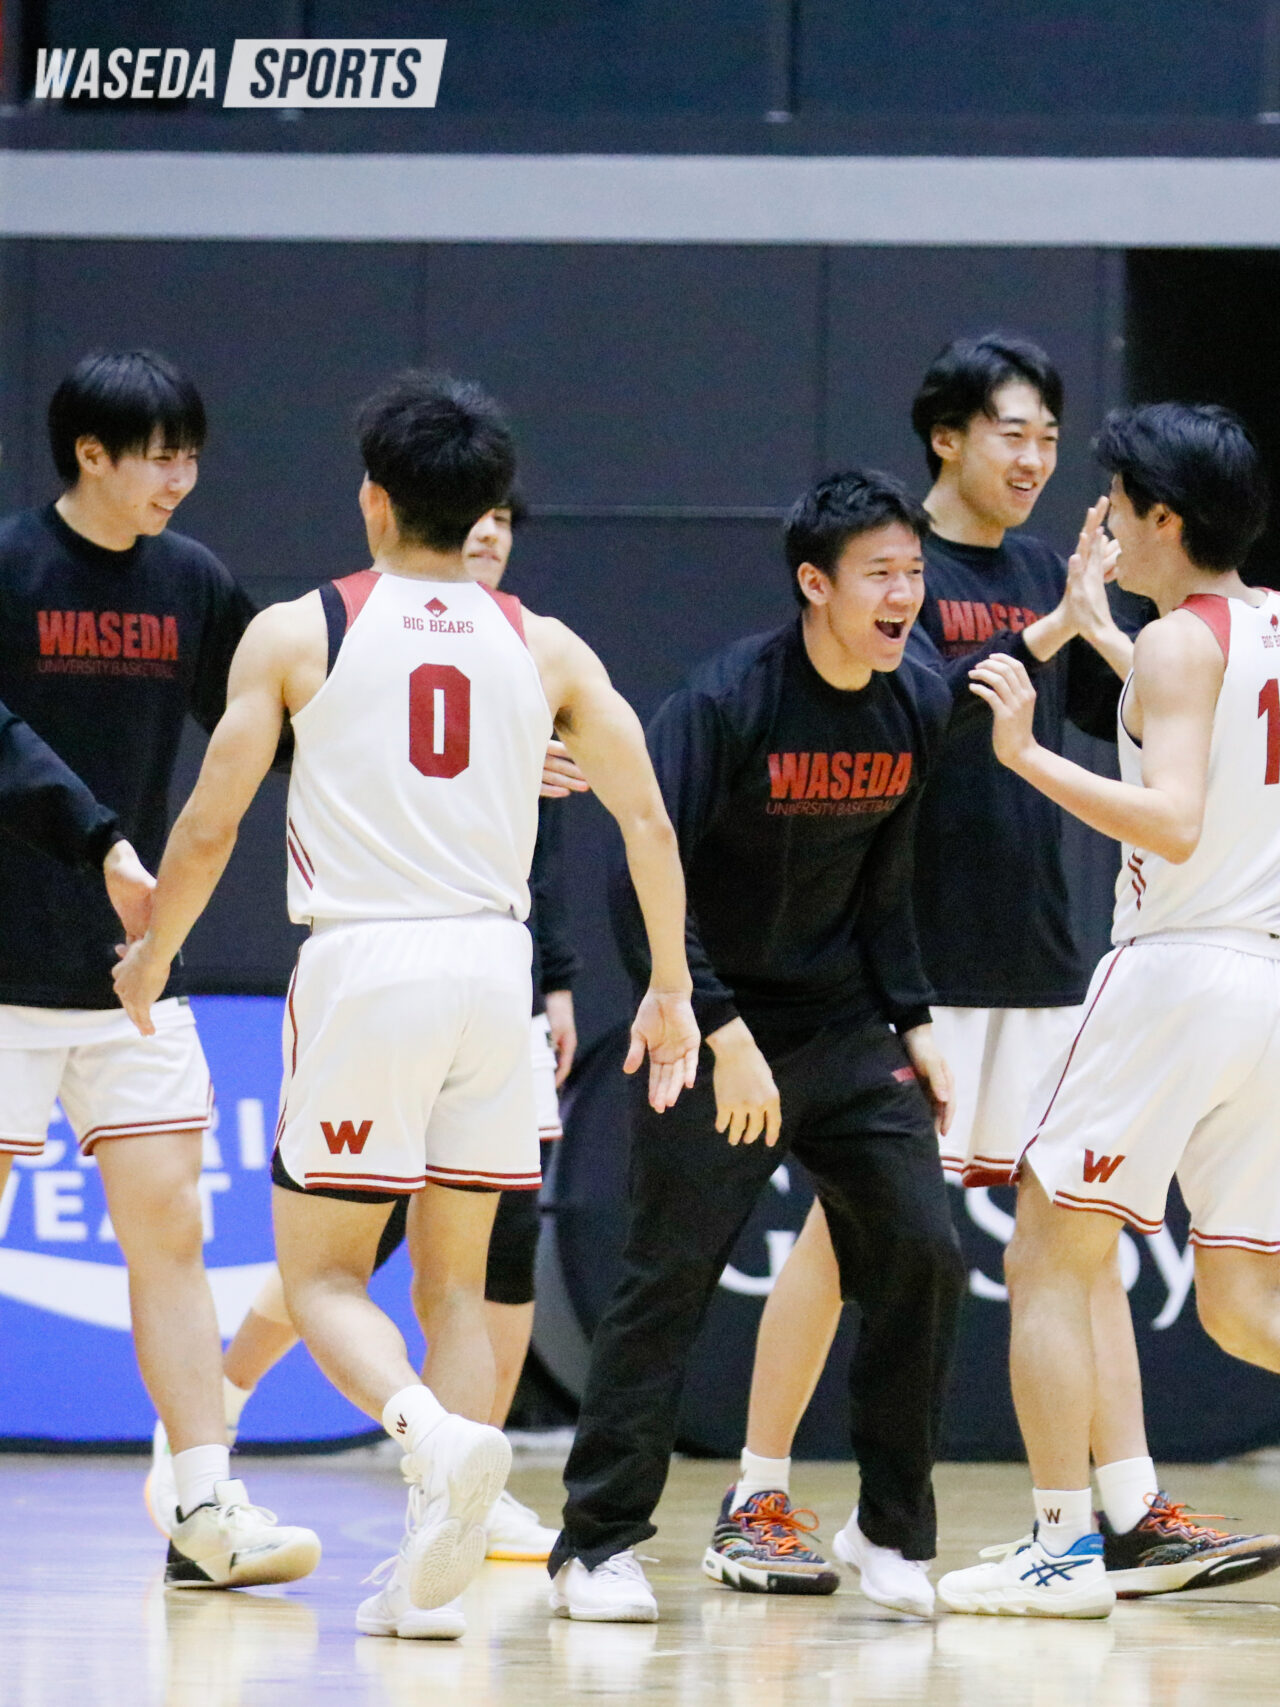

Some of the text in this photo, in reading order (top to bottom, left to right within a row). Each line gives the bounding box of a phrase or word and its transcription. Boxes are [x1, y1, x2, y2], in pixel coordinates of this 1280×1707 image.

[37, 610, 179, 661] WASEDA
[402, 615, 475, 634] BIG BEARS
[938, 599, 1045, 642] WASED
[408, 662, 471, 779] 0
[767, 752, 913, 801] WASEDA
[319, 1120, 374, 1155] W
[1083, 1148, 1126, 1184] W
[1043, 1507, 1062, 1525] W
